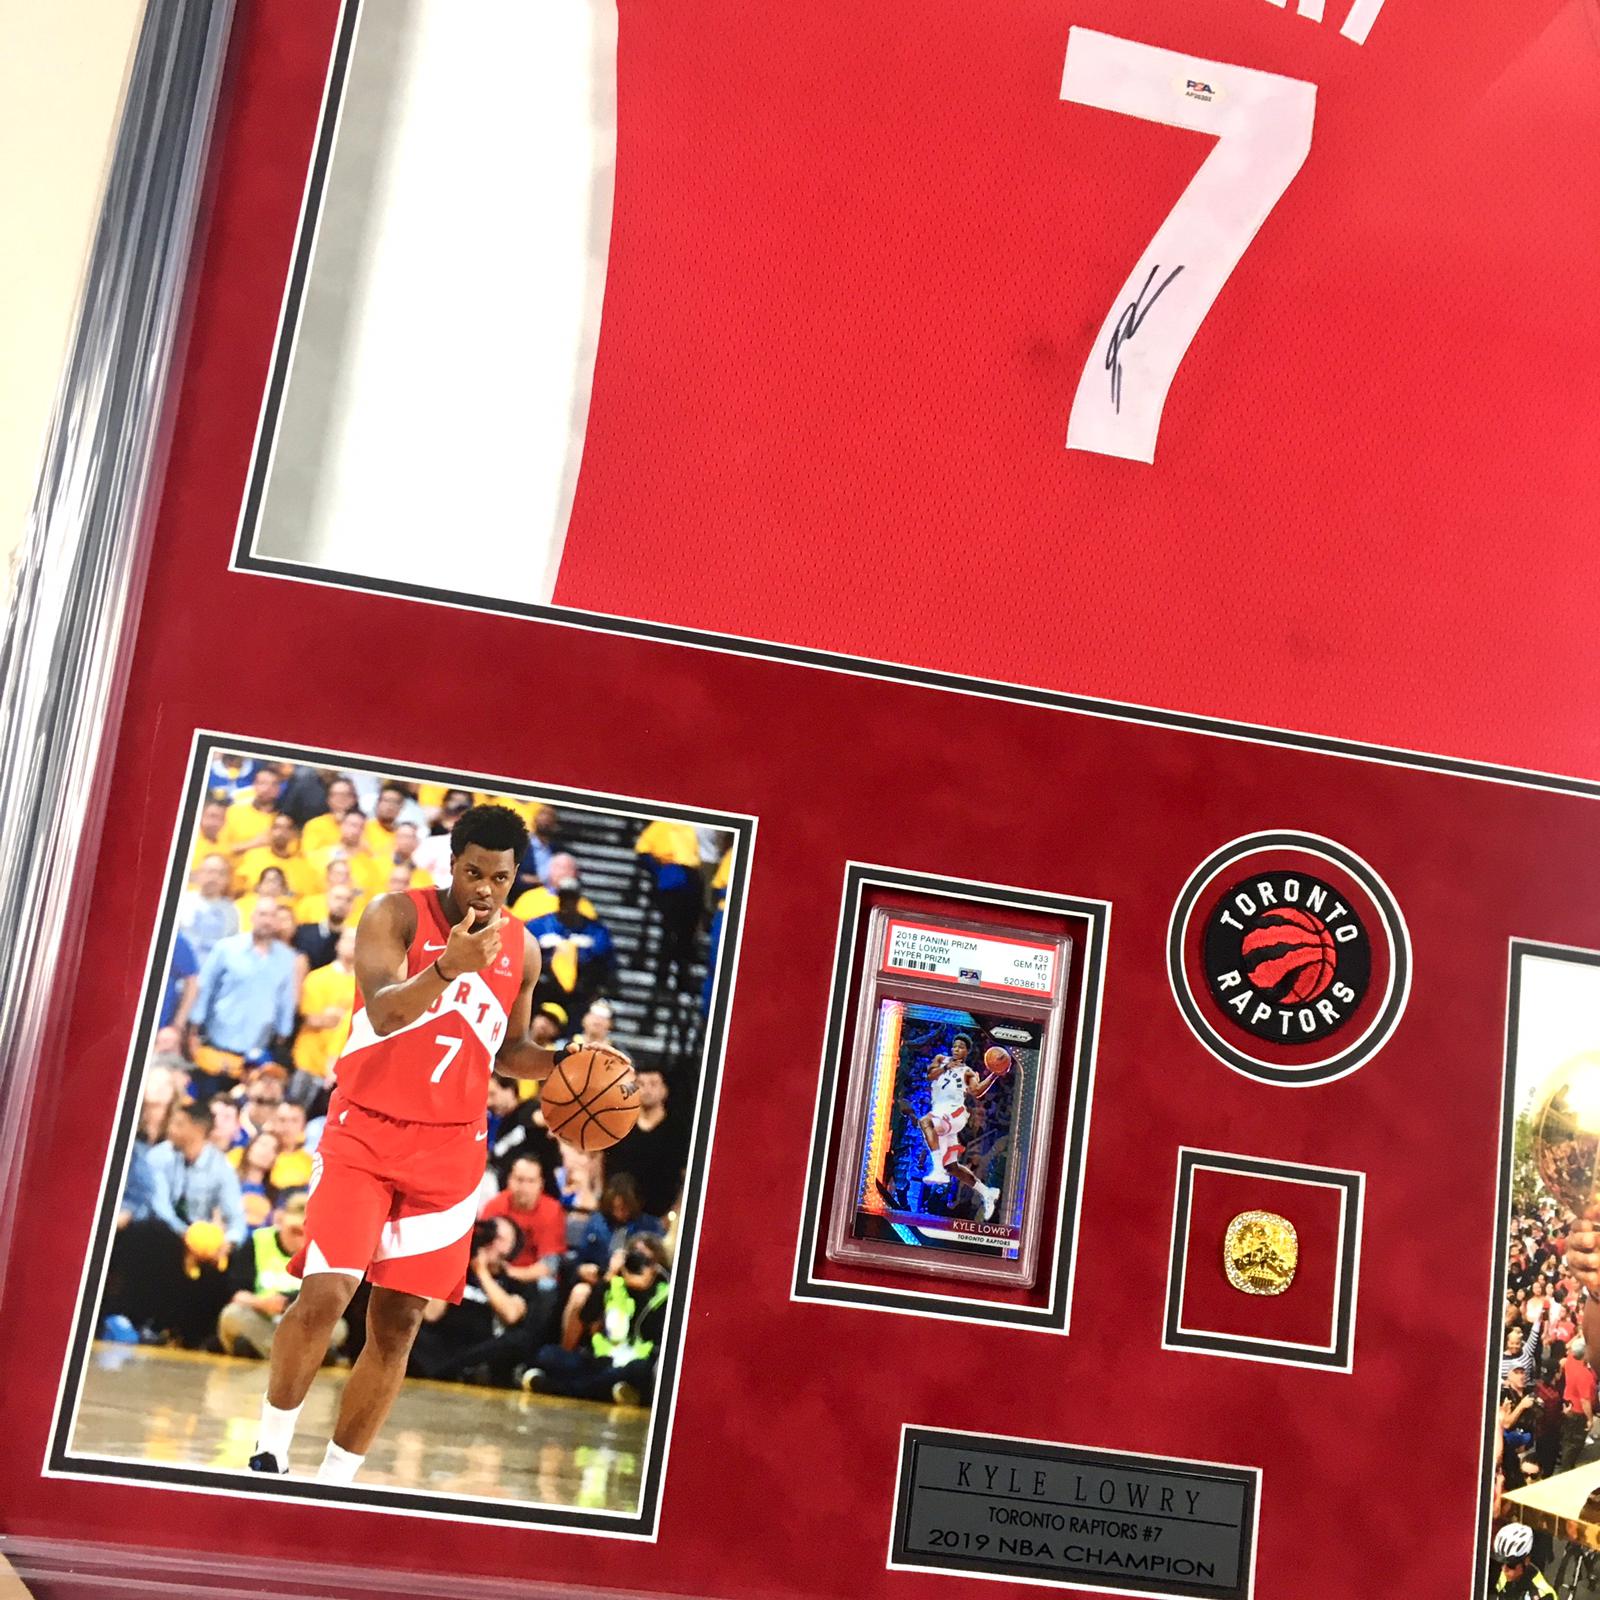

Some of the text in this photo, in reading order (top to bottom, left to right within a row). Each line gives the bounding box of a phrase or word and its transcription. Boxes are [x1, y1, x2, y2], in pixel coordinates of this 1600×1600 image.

[1059, 25, 1318, 465] 7
[1220, 878, 1359, 943] TORONTO
[895, 940, 950, 955] KYLE LOWRY
[896, 930, 978, 951] 2018 PANINI PRIZM
[893, 949, 950, 965] HYPER PRIZM
[1013, 959, 1047, 971] GEM MT
[1033, 954, 1049, 963] #33
[1003, 976, 1046, 991] 52038613
[1037, 972, 1047, 981] 10
[1216, 969, 1356, 1036] RAPTORS
[429, 1035, 463, 1083] 7
[941, 1077, 951, 1090] 7
[952, 1220, 1013, 1237] KYLE LOWRY
[957, 1234, 1011, 1247] TORONTO RAPTORS
[957, 1461, 1201, 1515] KYLE LOWRY
[988, 1506, 1163, 1543] TORONTO RAPTORS #7
[928, 1529, 1216, 1579] 2019 NBA CHAMPION
